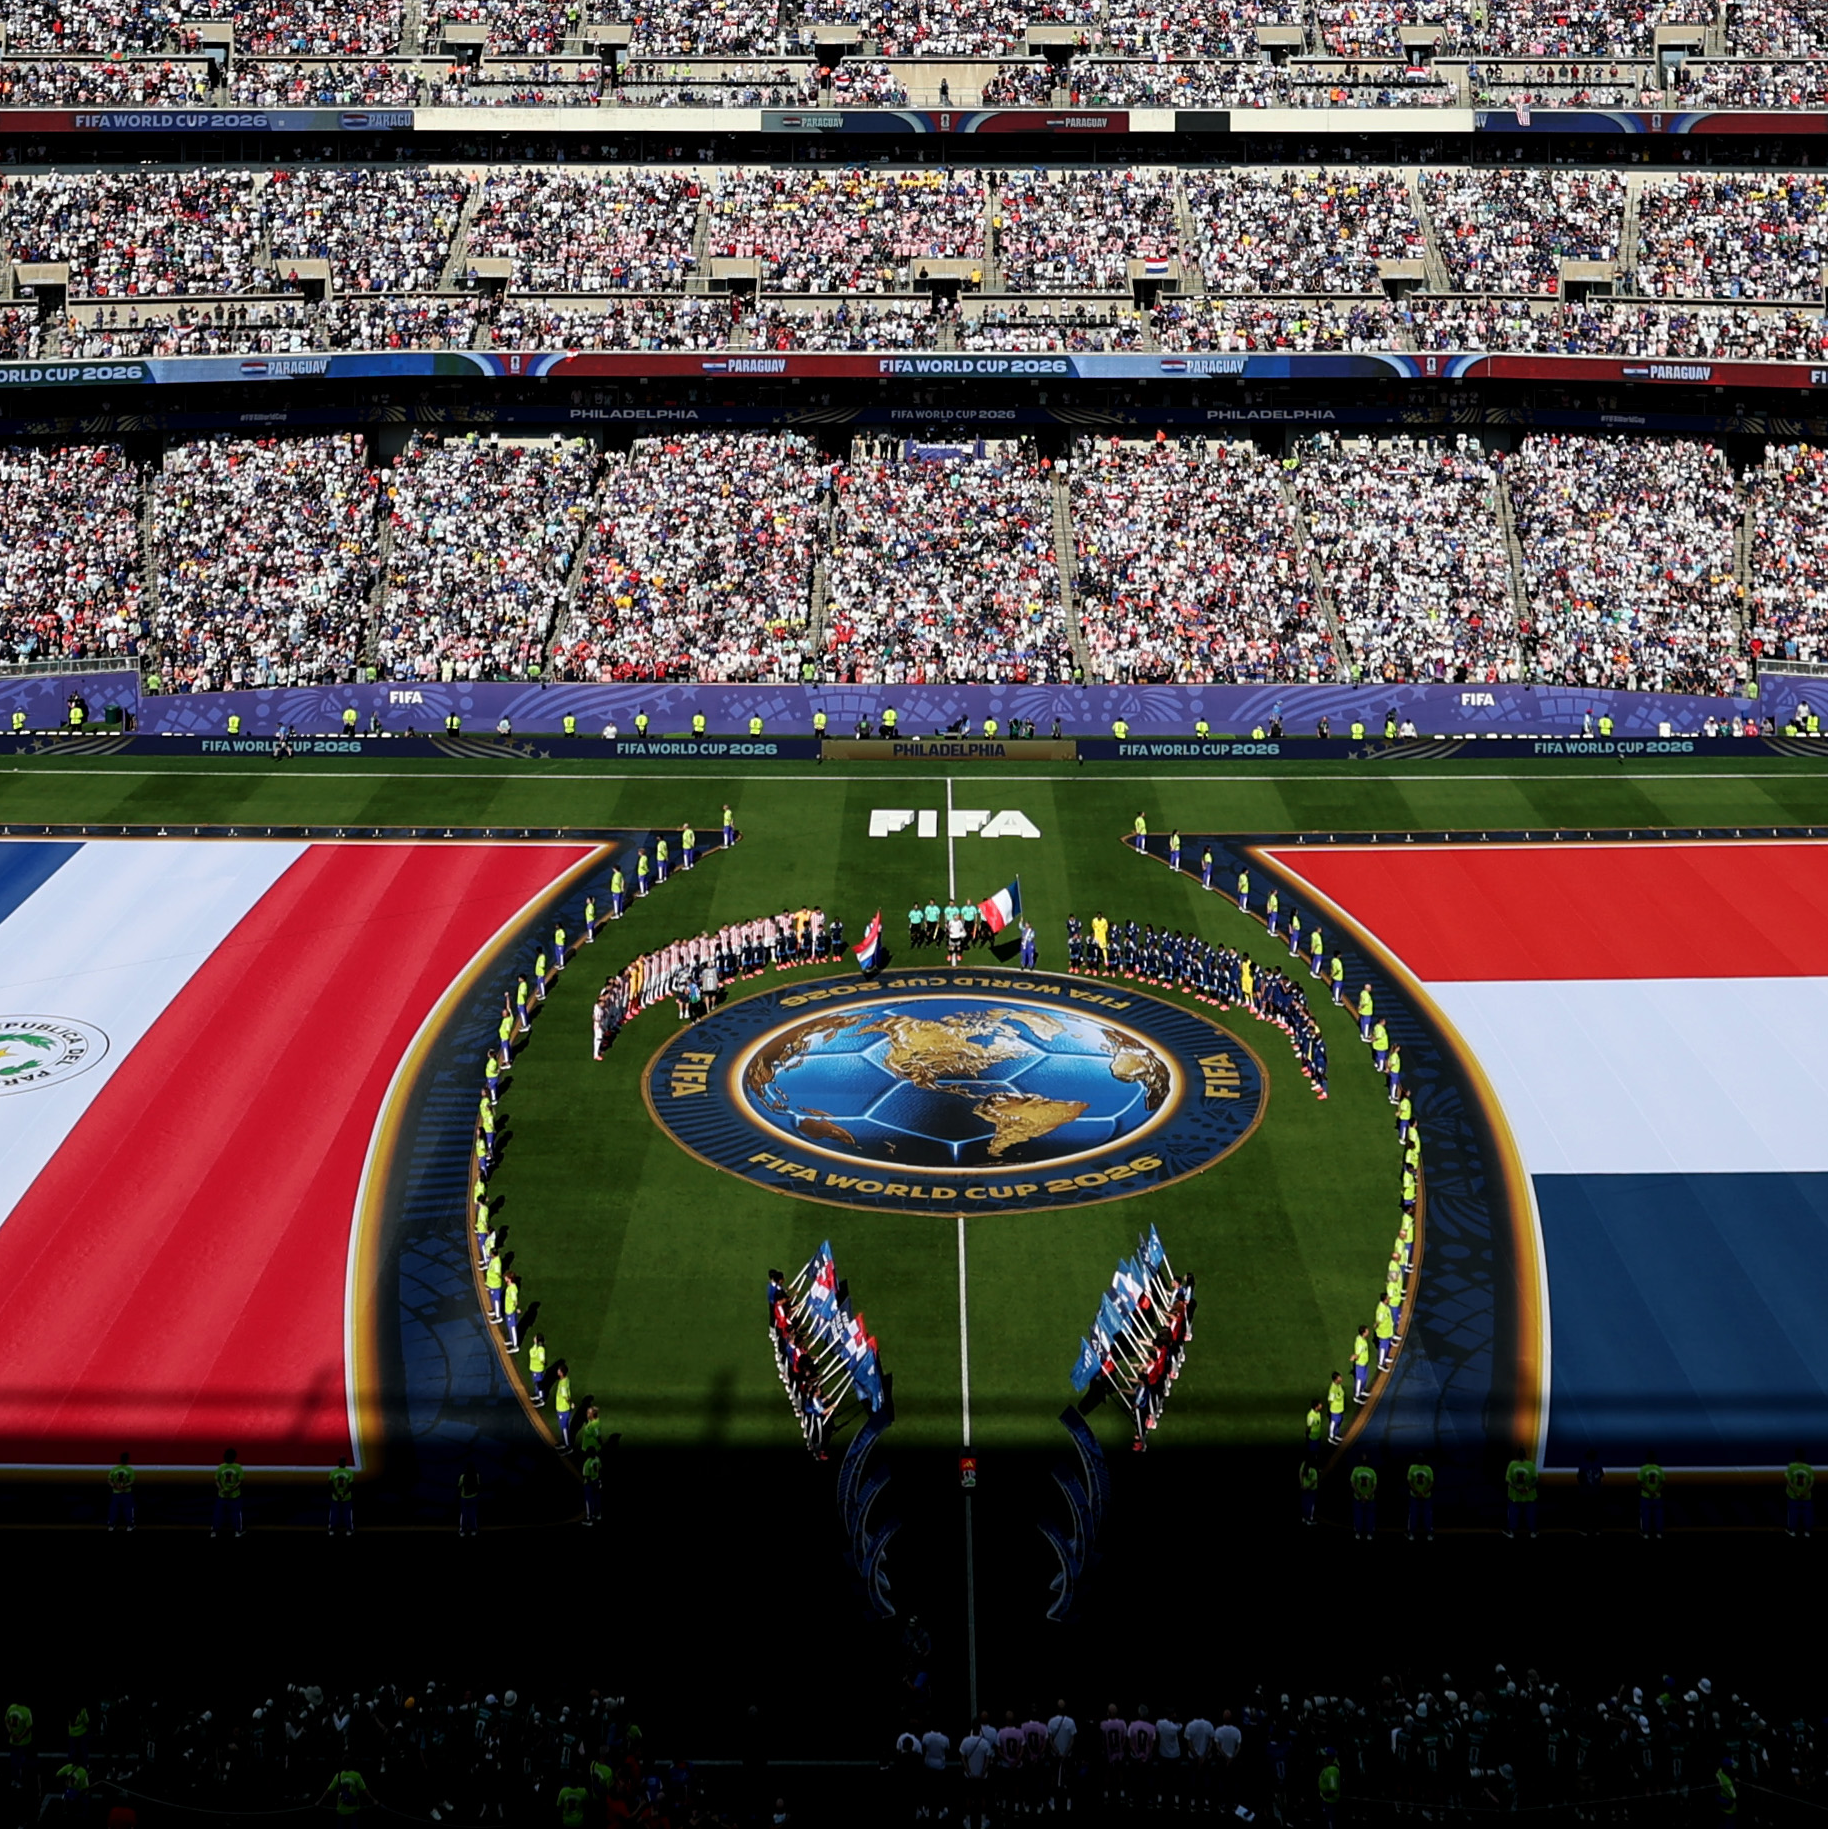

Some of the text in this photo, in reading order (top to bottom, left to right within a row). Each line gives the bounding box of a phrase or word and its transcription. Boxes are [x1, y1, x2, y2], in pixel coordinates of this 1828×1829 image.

[75, 114, 268, 128] FIFA WORLD CUP 2026
[368, 114, 414, 127] PARAGU
[801, 117, 844, 128] PARAGUAY
[1065, 117, 1108, 128] PARAGUAY
[267, 359, 328, 375] PARAGUAY
[727, 359, 786, 373] PARAGUAY
[879, 359, 1068, 373] FIFA WORLD CUP 2026
[1186, 359, 1245, 374] PARAGUAY
[1649, 364, 1711, 381] PARAGUAY
[44, 367, 80, 382] CUP
[82, 366, 143, 381] 2026
[569, 409, 699, 420] PHILADELPHIA
[890, 410, 1017, 419] FIFA WORLD CUP 2026
[1206, 409, 1336, 420] PHILADELPHIA
[389, 690, 423, 704] FIFA
[1461, 692, 1495, 706] FIFA
[201, 740, 230, 751] FIFA
[313, 740, 362, 752] 2026
[617, 743, 778, 755] FIFA WORLD CUP 2026
[893, 743, 1006, 757] PHILADELPHIA
[1119, 743, 1280, 756] FIFA WORLD CUP 2026
[1534, 741, 1694, 754] FIFA WORLD CUP 2026
[868, 809, 1041, 838] FIFA
[779, 977, 1131, 1010] FIFA WORLD CUP 2026
[55, 1047, 84, 1067] DEL
[670, 1051, 717, 1099] FIFA
[1197, 1052, 1241, 1099] FIFA
[747, 1152, 1163, 1201] FIFA WORLD CUP 2026
